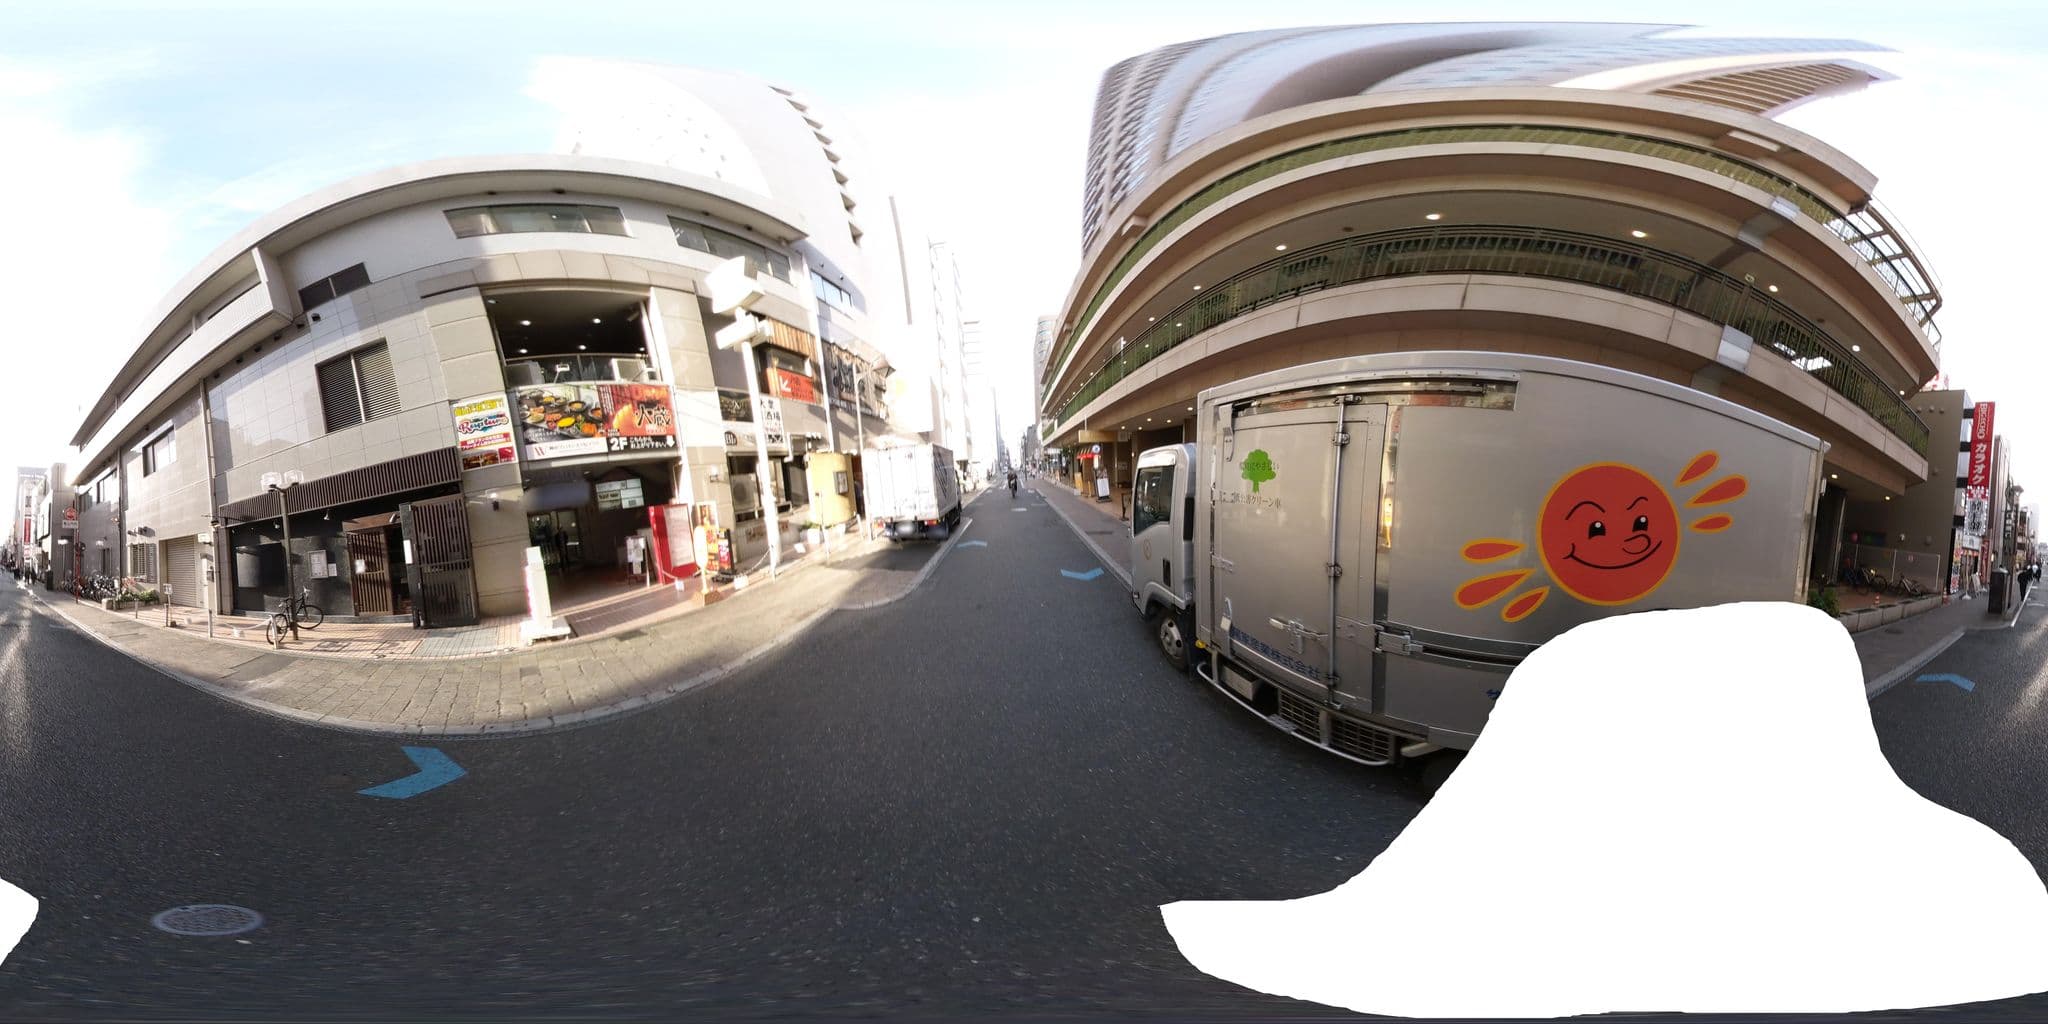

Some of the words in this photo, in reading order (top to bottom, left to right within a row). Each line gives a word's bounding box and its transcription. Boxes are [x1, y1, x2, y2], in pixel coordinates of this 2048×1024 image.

[610, 437, 628, 451] 2F
[1972, 443, 1987, 485] カラオケ
